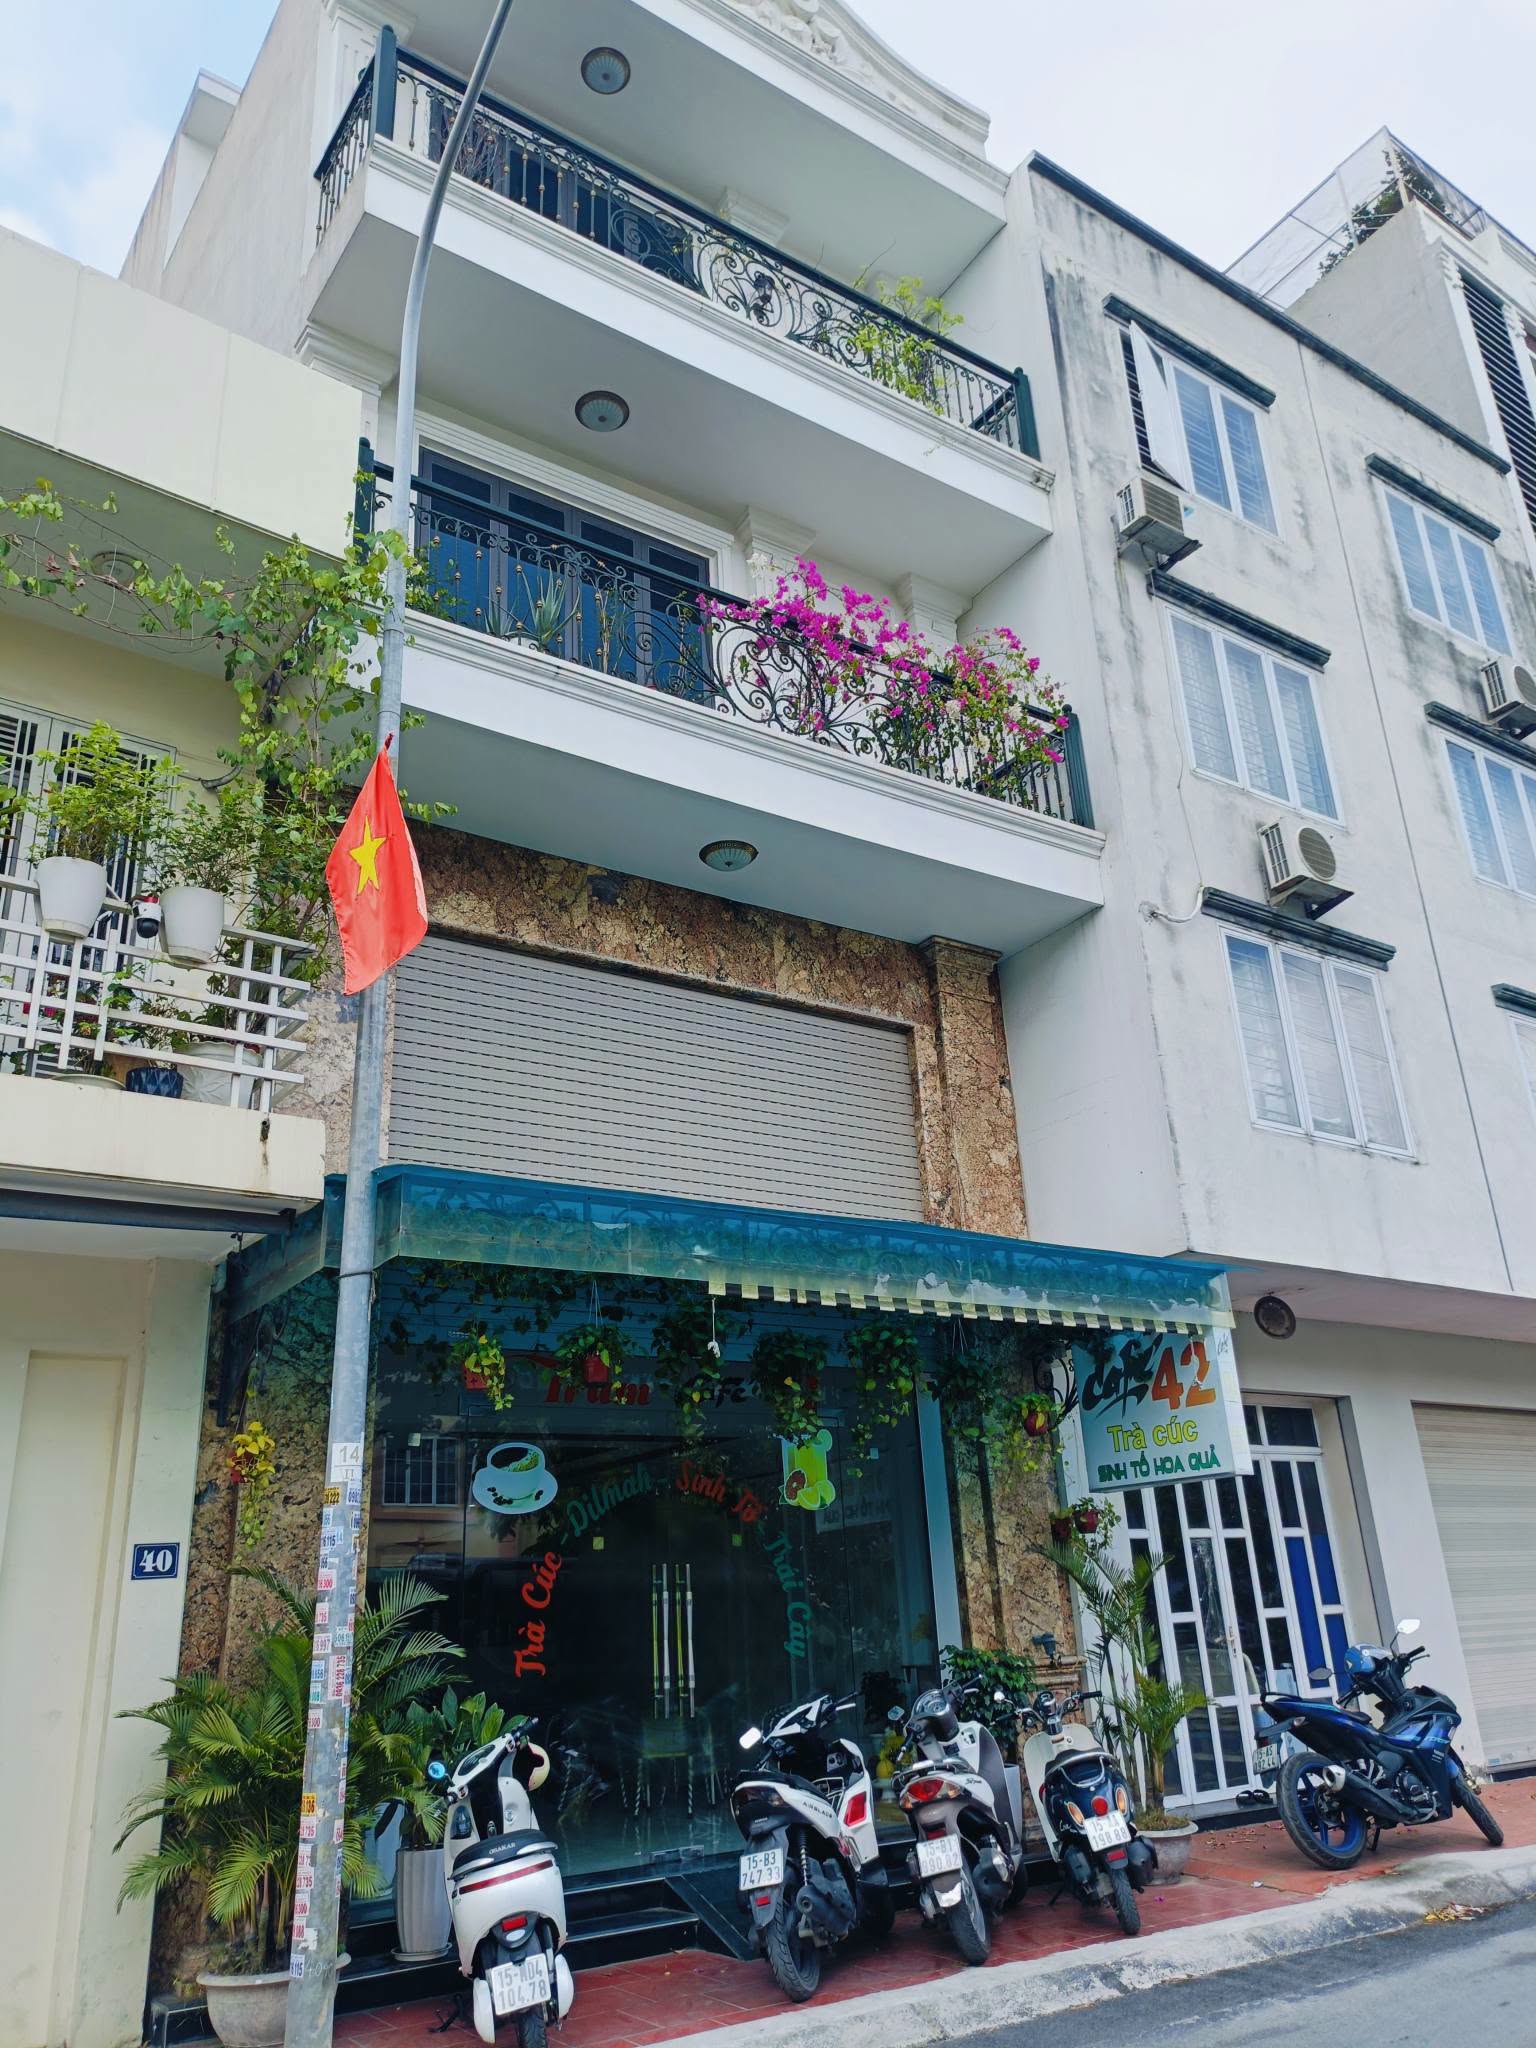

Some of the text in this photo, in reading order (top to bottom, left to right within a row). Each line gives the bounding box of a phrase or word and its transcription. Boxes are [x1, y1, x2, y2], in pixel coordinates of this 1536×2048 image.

[1152, 1341, 1216, 1410] 42
[1107, 1416, 1199, 1452] Trà cúc
[339, 1445, 360, 1463] 14
[1154, 1456, 1185, 1475] HOA
[139, 1549, 173, 1572] 40
[747, 1851, 776, 1870] 15-B3
